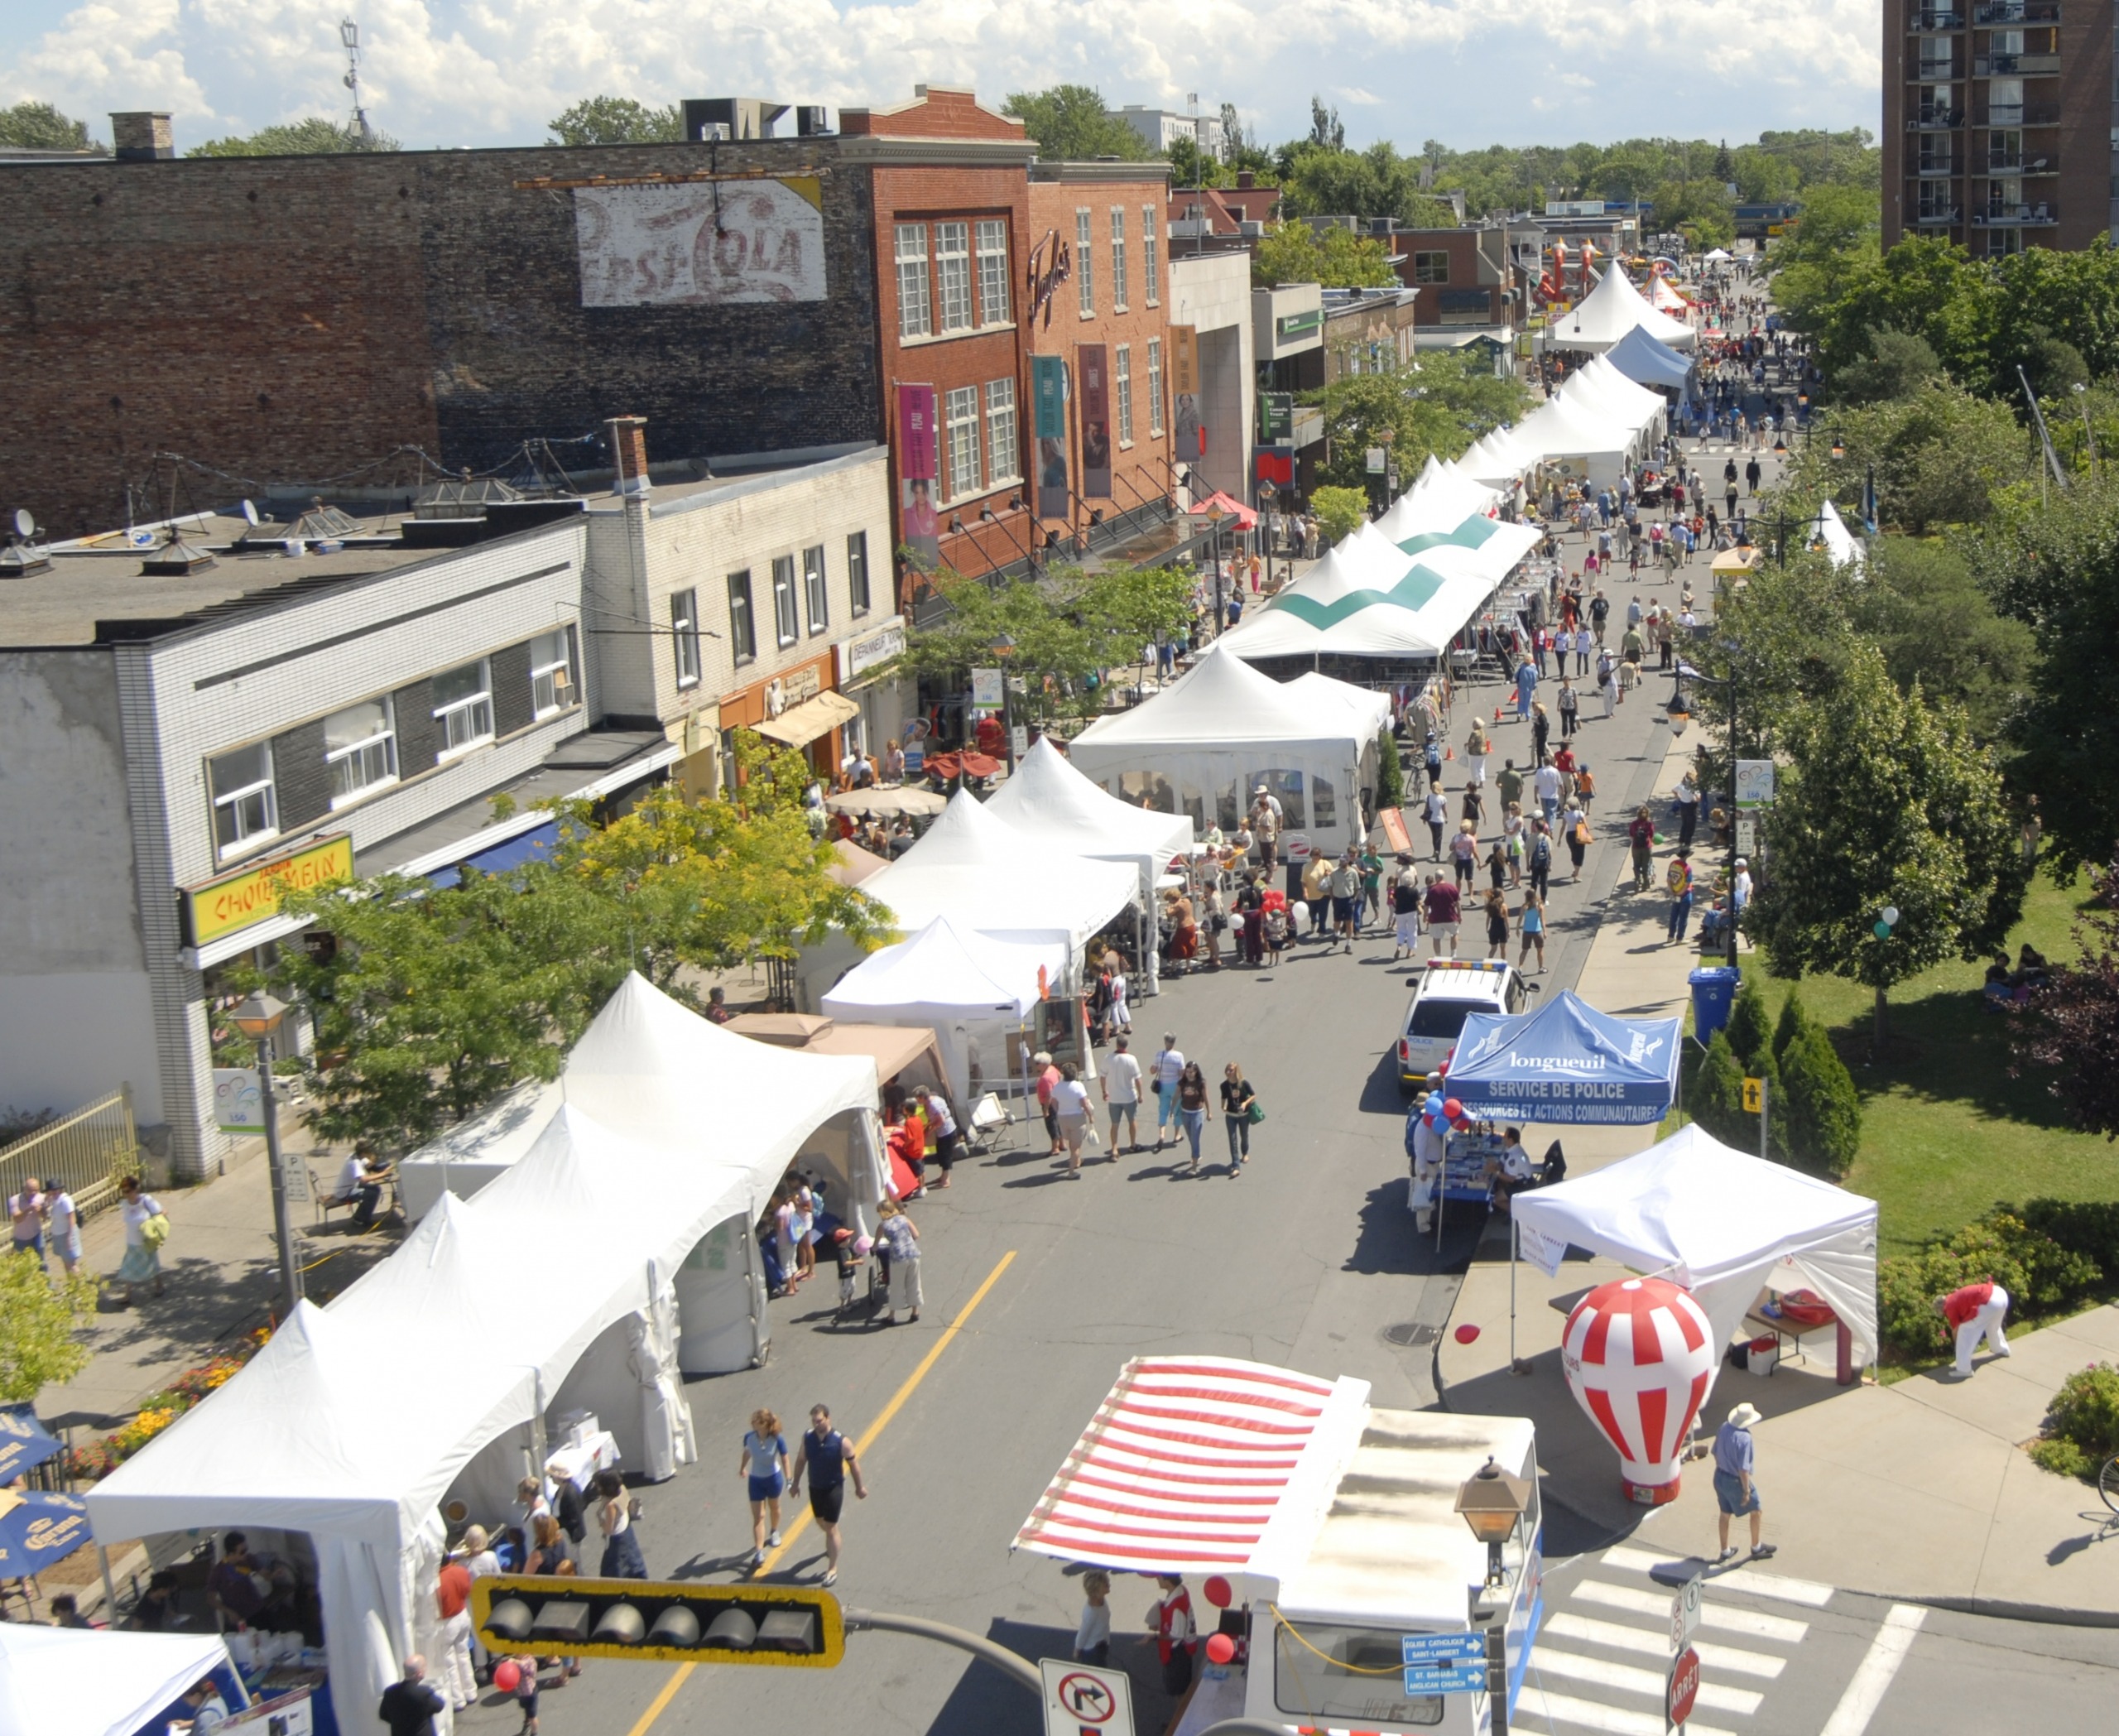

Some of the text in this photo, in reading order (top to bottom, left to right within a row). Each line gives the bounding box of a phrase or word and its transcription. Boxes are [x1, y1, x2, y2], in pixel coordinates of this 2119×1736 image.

[1043, 379, 1054, 395] PEAU
[911, 413, 924, 430] PEAU
[1408, 1037, 1434, 1046] POLICE
[1510, 1051, 1606, 1073] longueuil
[1489, 1081, 1625, 1099] SERVICE DE POLICE
[1521, 1104, 1533, 1118] ET
[1535, 1104, 1572, 1121] ACTIONS
[1575, 1104, 1658, 1122] COMMUNAUTAIRES
[290, 1157, 298, 1166] P
[25, 1514, 86, 1551] Corona
[1429, 1637, 1466, 1647] CATHOLIQUE
[1412, 1648, 1460, 1658] SAINT-LAMBERT
[1409, 1680, 1466, 1690] ANGLICAN CHURCH
[1671, 1663, 1699, 1711] ARRÊT
